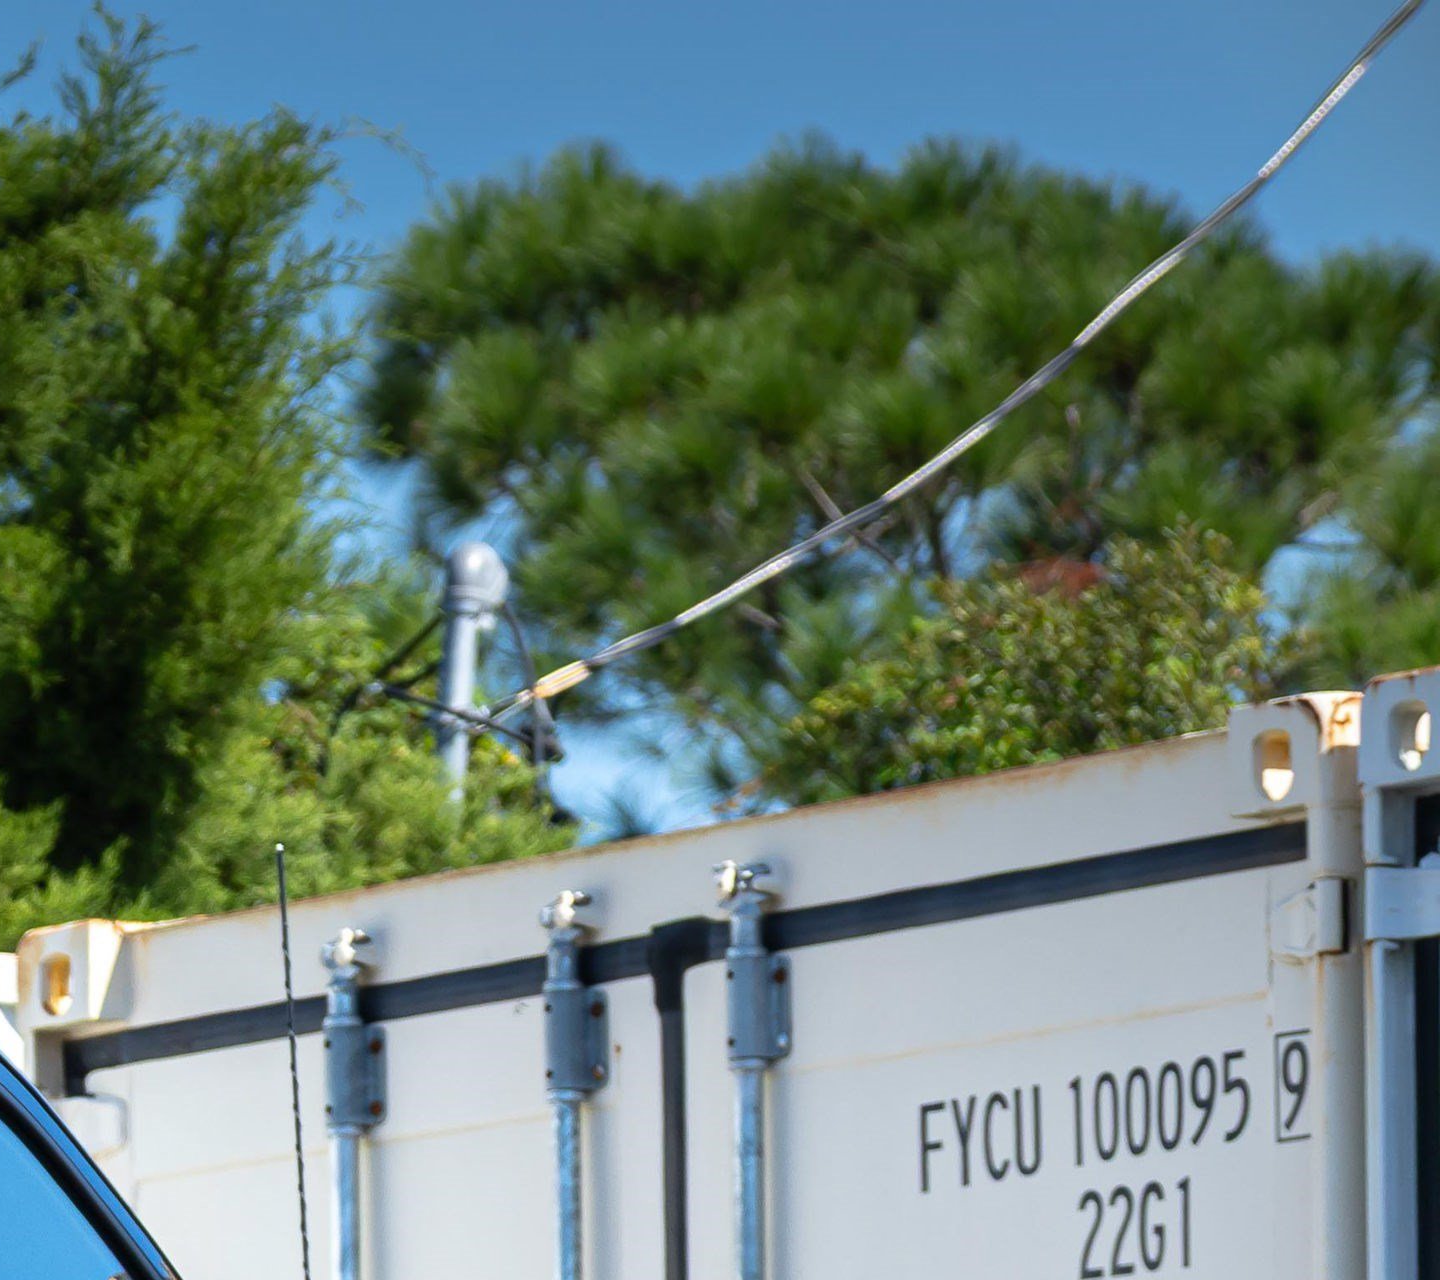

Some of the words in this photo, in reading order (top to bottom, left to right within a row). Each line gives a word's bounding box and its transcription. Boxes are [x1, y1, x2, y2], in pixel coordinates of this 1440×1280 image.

[919, 1084, 1043, 1194] FYCU
[1069, 1049, 1251, 1167] 100095
[1280, 1039, 1311, 1131] 9
[1078, 1176, 1191, 1280] 22G1
